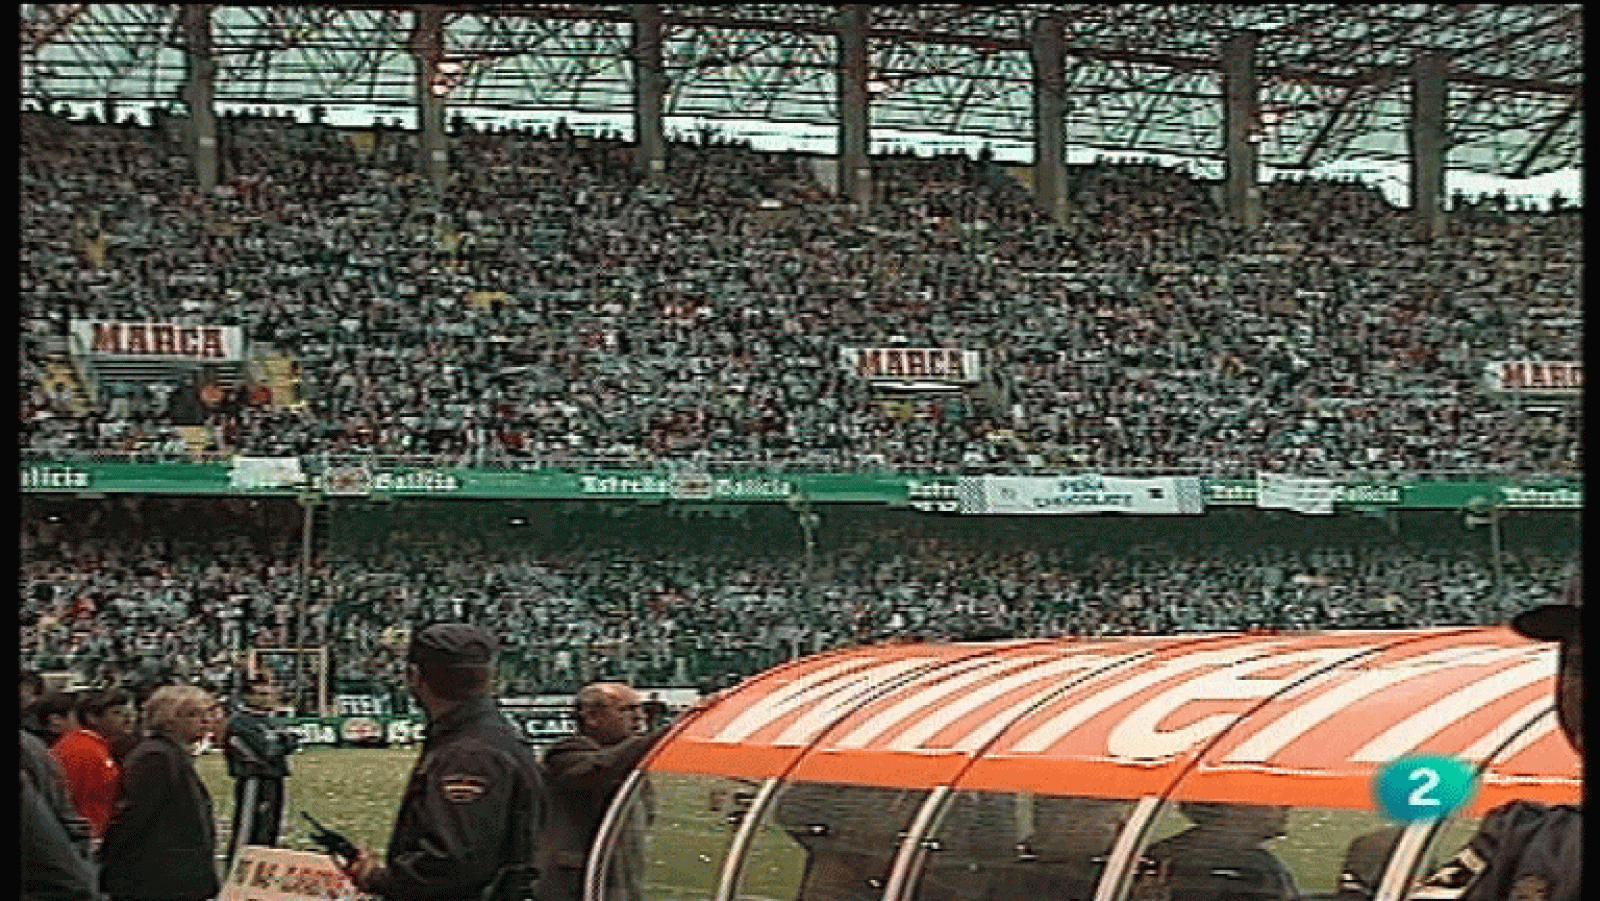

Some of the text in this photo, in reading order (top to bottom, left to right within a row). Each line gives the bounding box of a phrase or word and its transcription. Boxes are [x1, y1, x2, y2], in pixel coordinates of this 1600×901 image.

[92, 322, 226, 357] MARCA
[857, 350, 965, 376] MARCA
[580, 475, 790, 495] Estrella Galicia
